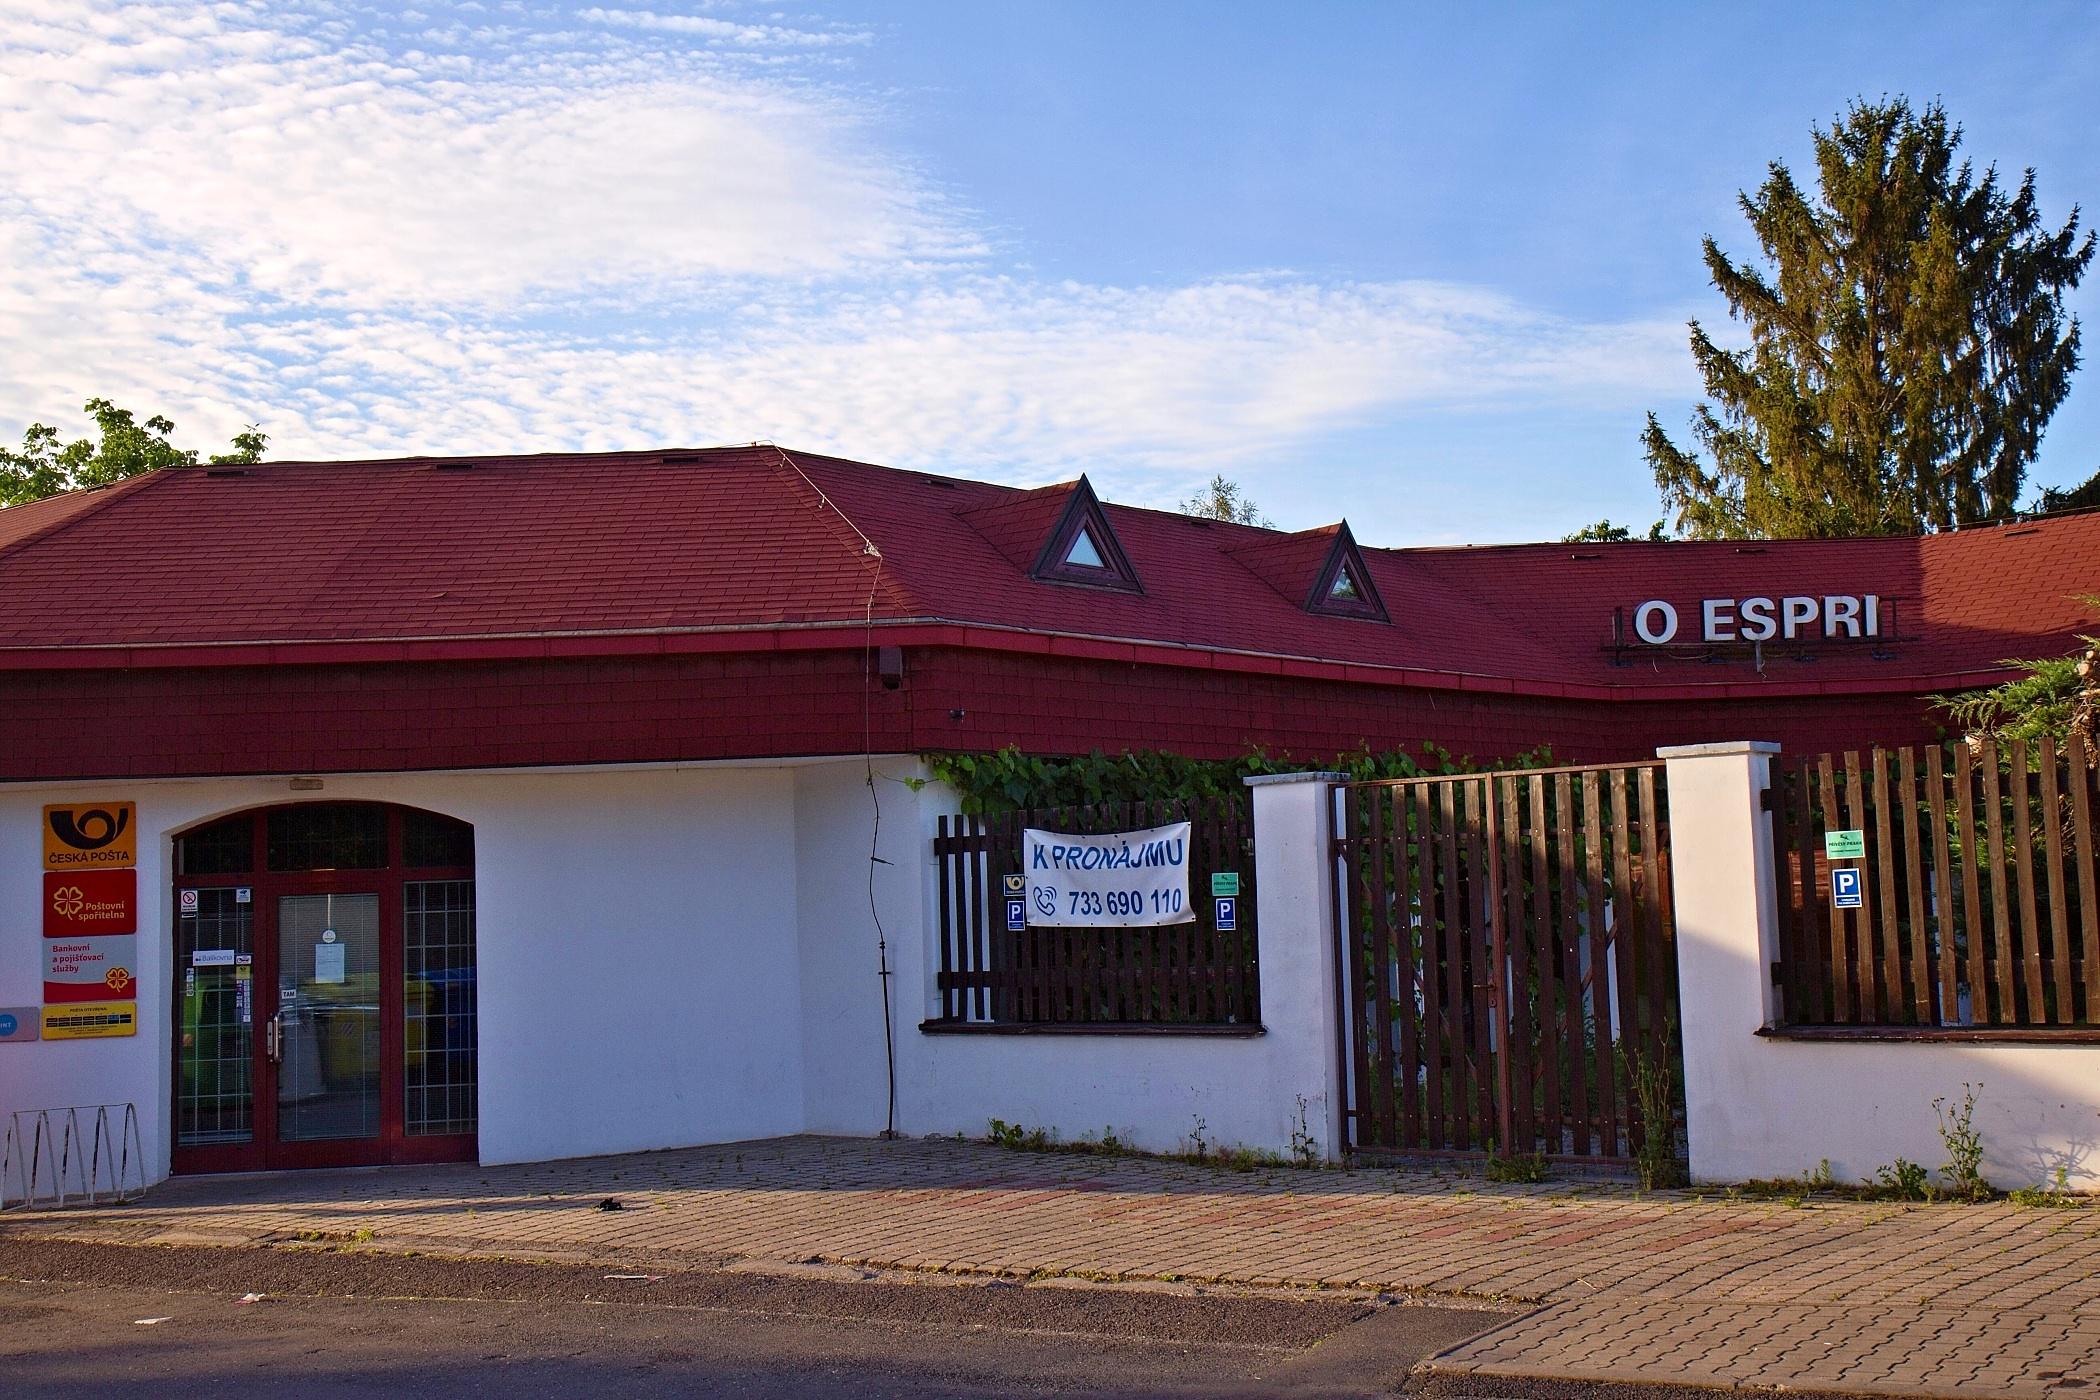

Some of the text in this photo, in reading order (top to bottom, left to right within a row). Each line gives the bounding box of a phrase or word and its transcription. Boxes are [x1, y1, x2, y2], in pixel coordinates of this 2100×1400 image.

[1635, 595, 1879, 644] O ESPRI
[49, 850, 129, 864] ČESKÁ POŠTA
[1033, 839, 1183, 871] K PRONÁJMU
[1839, 873, 1854, 893] P
[85, 901, 125, 911] Poštovní
[1068, 888, 1181, 916] 733 690 110
[78, 910, 125, 922] spořitelna
[1011, 904, 1021, 920] P
[1220, 902, 1231, 918] P
[52, 944, 90, 953] Bankovní
[59, 953, 104, 964] pojišťovací
[52, 964, 79, 974] služby
[283, 990, 295, 998] TAM
